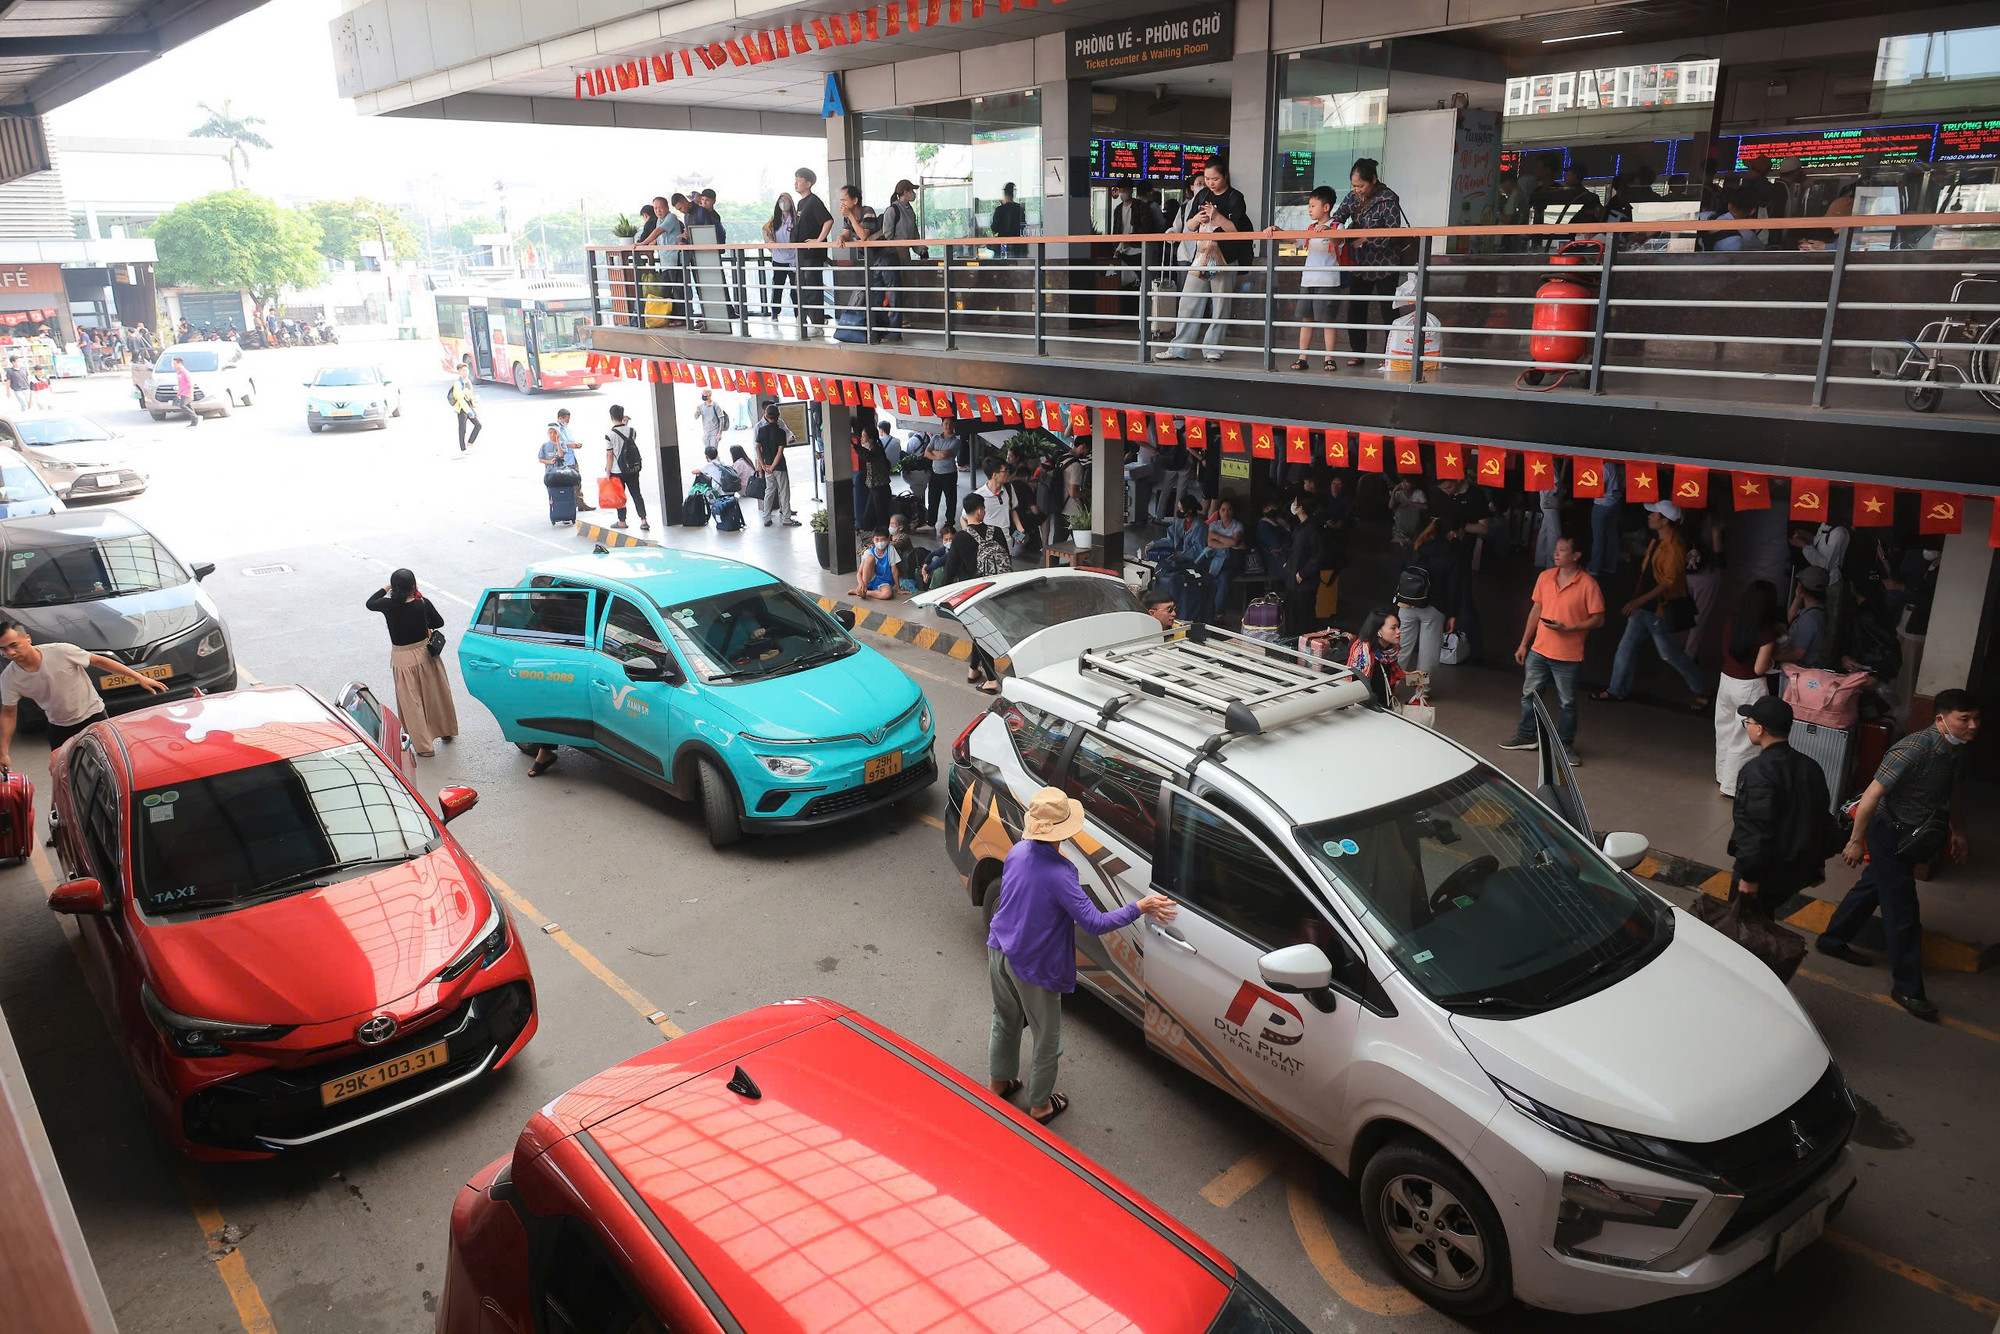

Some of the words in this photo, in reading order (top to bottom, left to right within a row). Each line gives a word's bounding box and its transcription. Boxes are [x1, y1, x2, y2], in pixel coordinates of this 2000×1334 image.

[1075, 33, 1114, 57] PHÒNG
[1117, 27, 1133, 49] VÉ
[1145, 20, 1188, 45] PHÒNG
[1192, 11, 1221, 37] CHỜ
[1085, 58, 1108, 70] Ticket
[1109, 54, 1139, 67] counter
[1141, 51, 1148, 61] &
[1150, 46, 1181, 60] Waiting
[1183, 43, 1209, 54] Room
[821, 73, 845, 119] A
[107, 668, 167, 687] 29K-1.80
[519, 669, 545, 681] 1900
[546, 671, 574, 682] 2088
[869, 763, 898, 782] 979.11
[876, 755, 892, 769] 29H
[154, 885, 197, 903] TAXI
[1214, 1017, 1251, 1045] DUC
[1222, 1032, 1295, 1077] TRANSPORT
[333, 1049, 436, 1099] 29K-103.31
